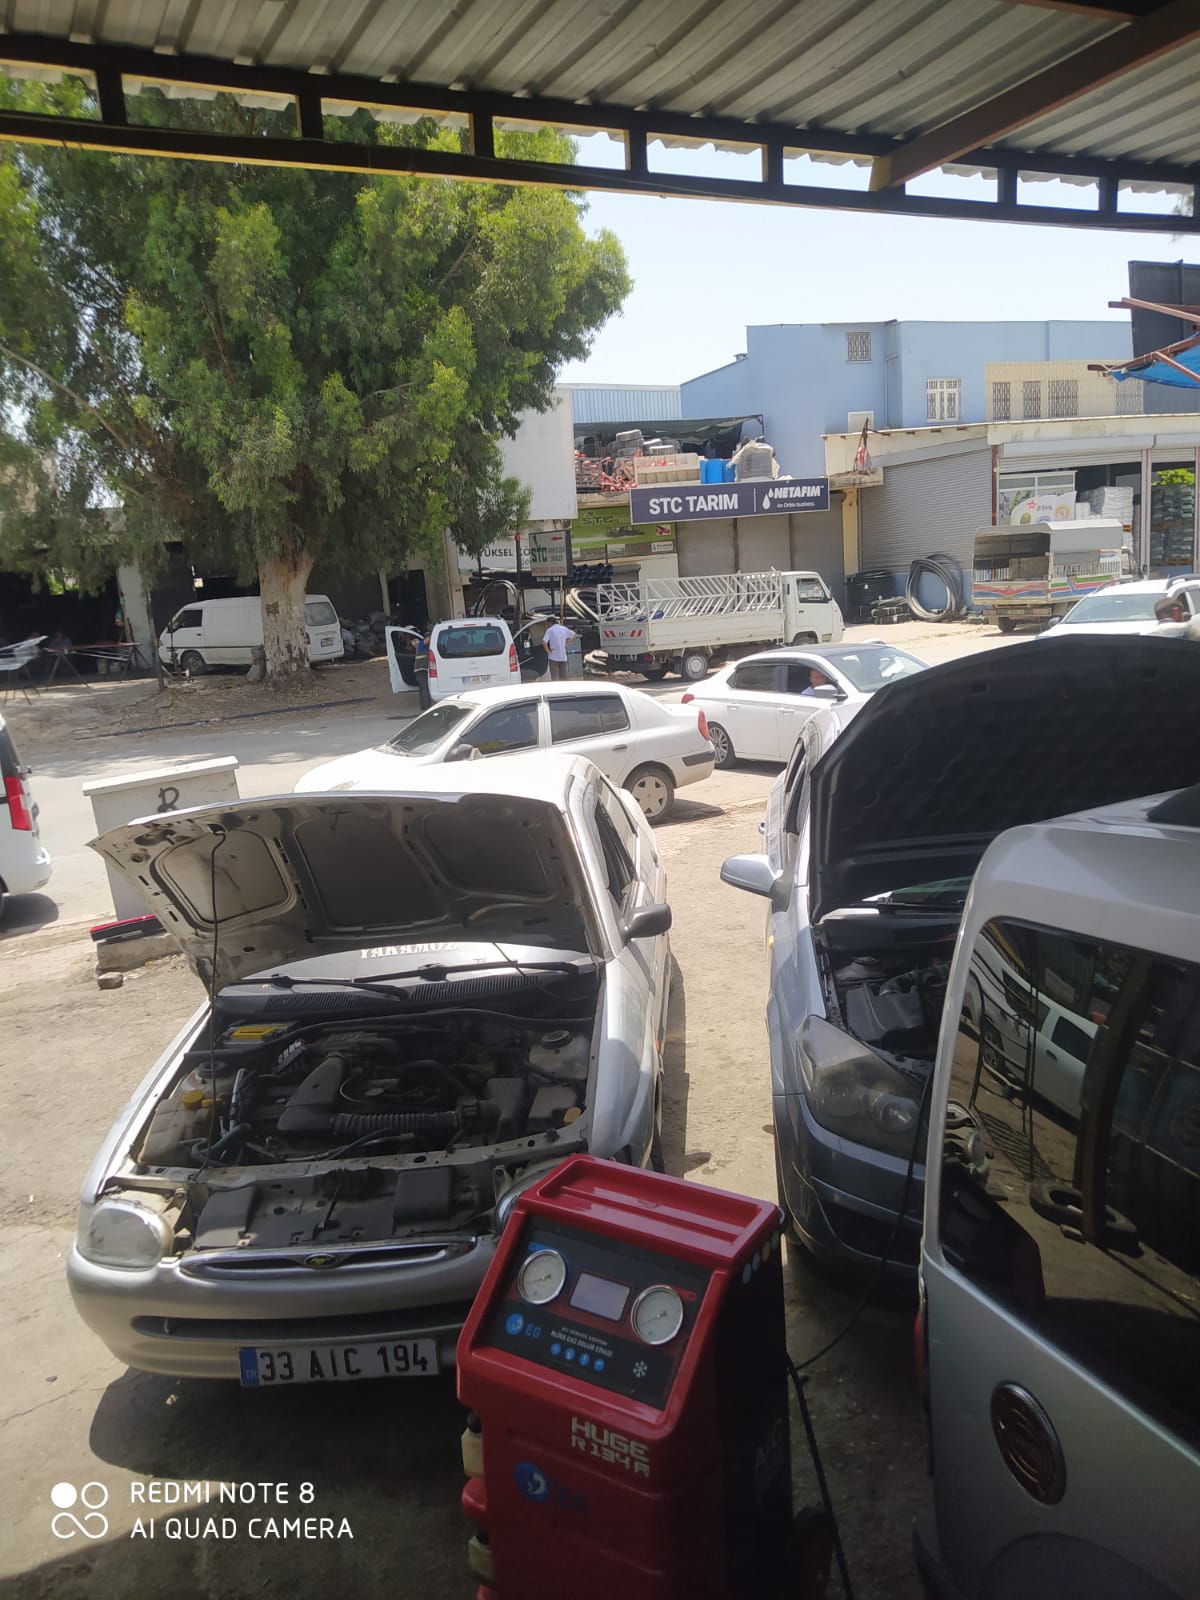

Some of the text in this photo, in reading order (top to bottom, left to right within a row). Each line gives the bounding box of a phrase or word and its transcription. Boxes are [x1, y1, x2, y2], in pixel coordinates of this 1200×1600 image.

[774, 485, 821, 499] NETAFIM
[649, 493, 739, 515] STC TARIM
[531, 545, 548, 563] STC
[259, 1343, 429, 1381] 33 AIC 194
[571, 1416, 650, 1463] HUGE
[571, 1434, 586, 1452] R
